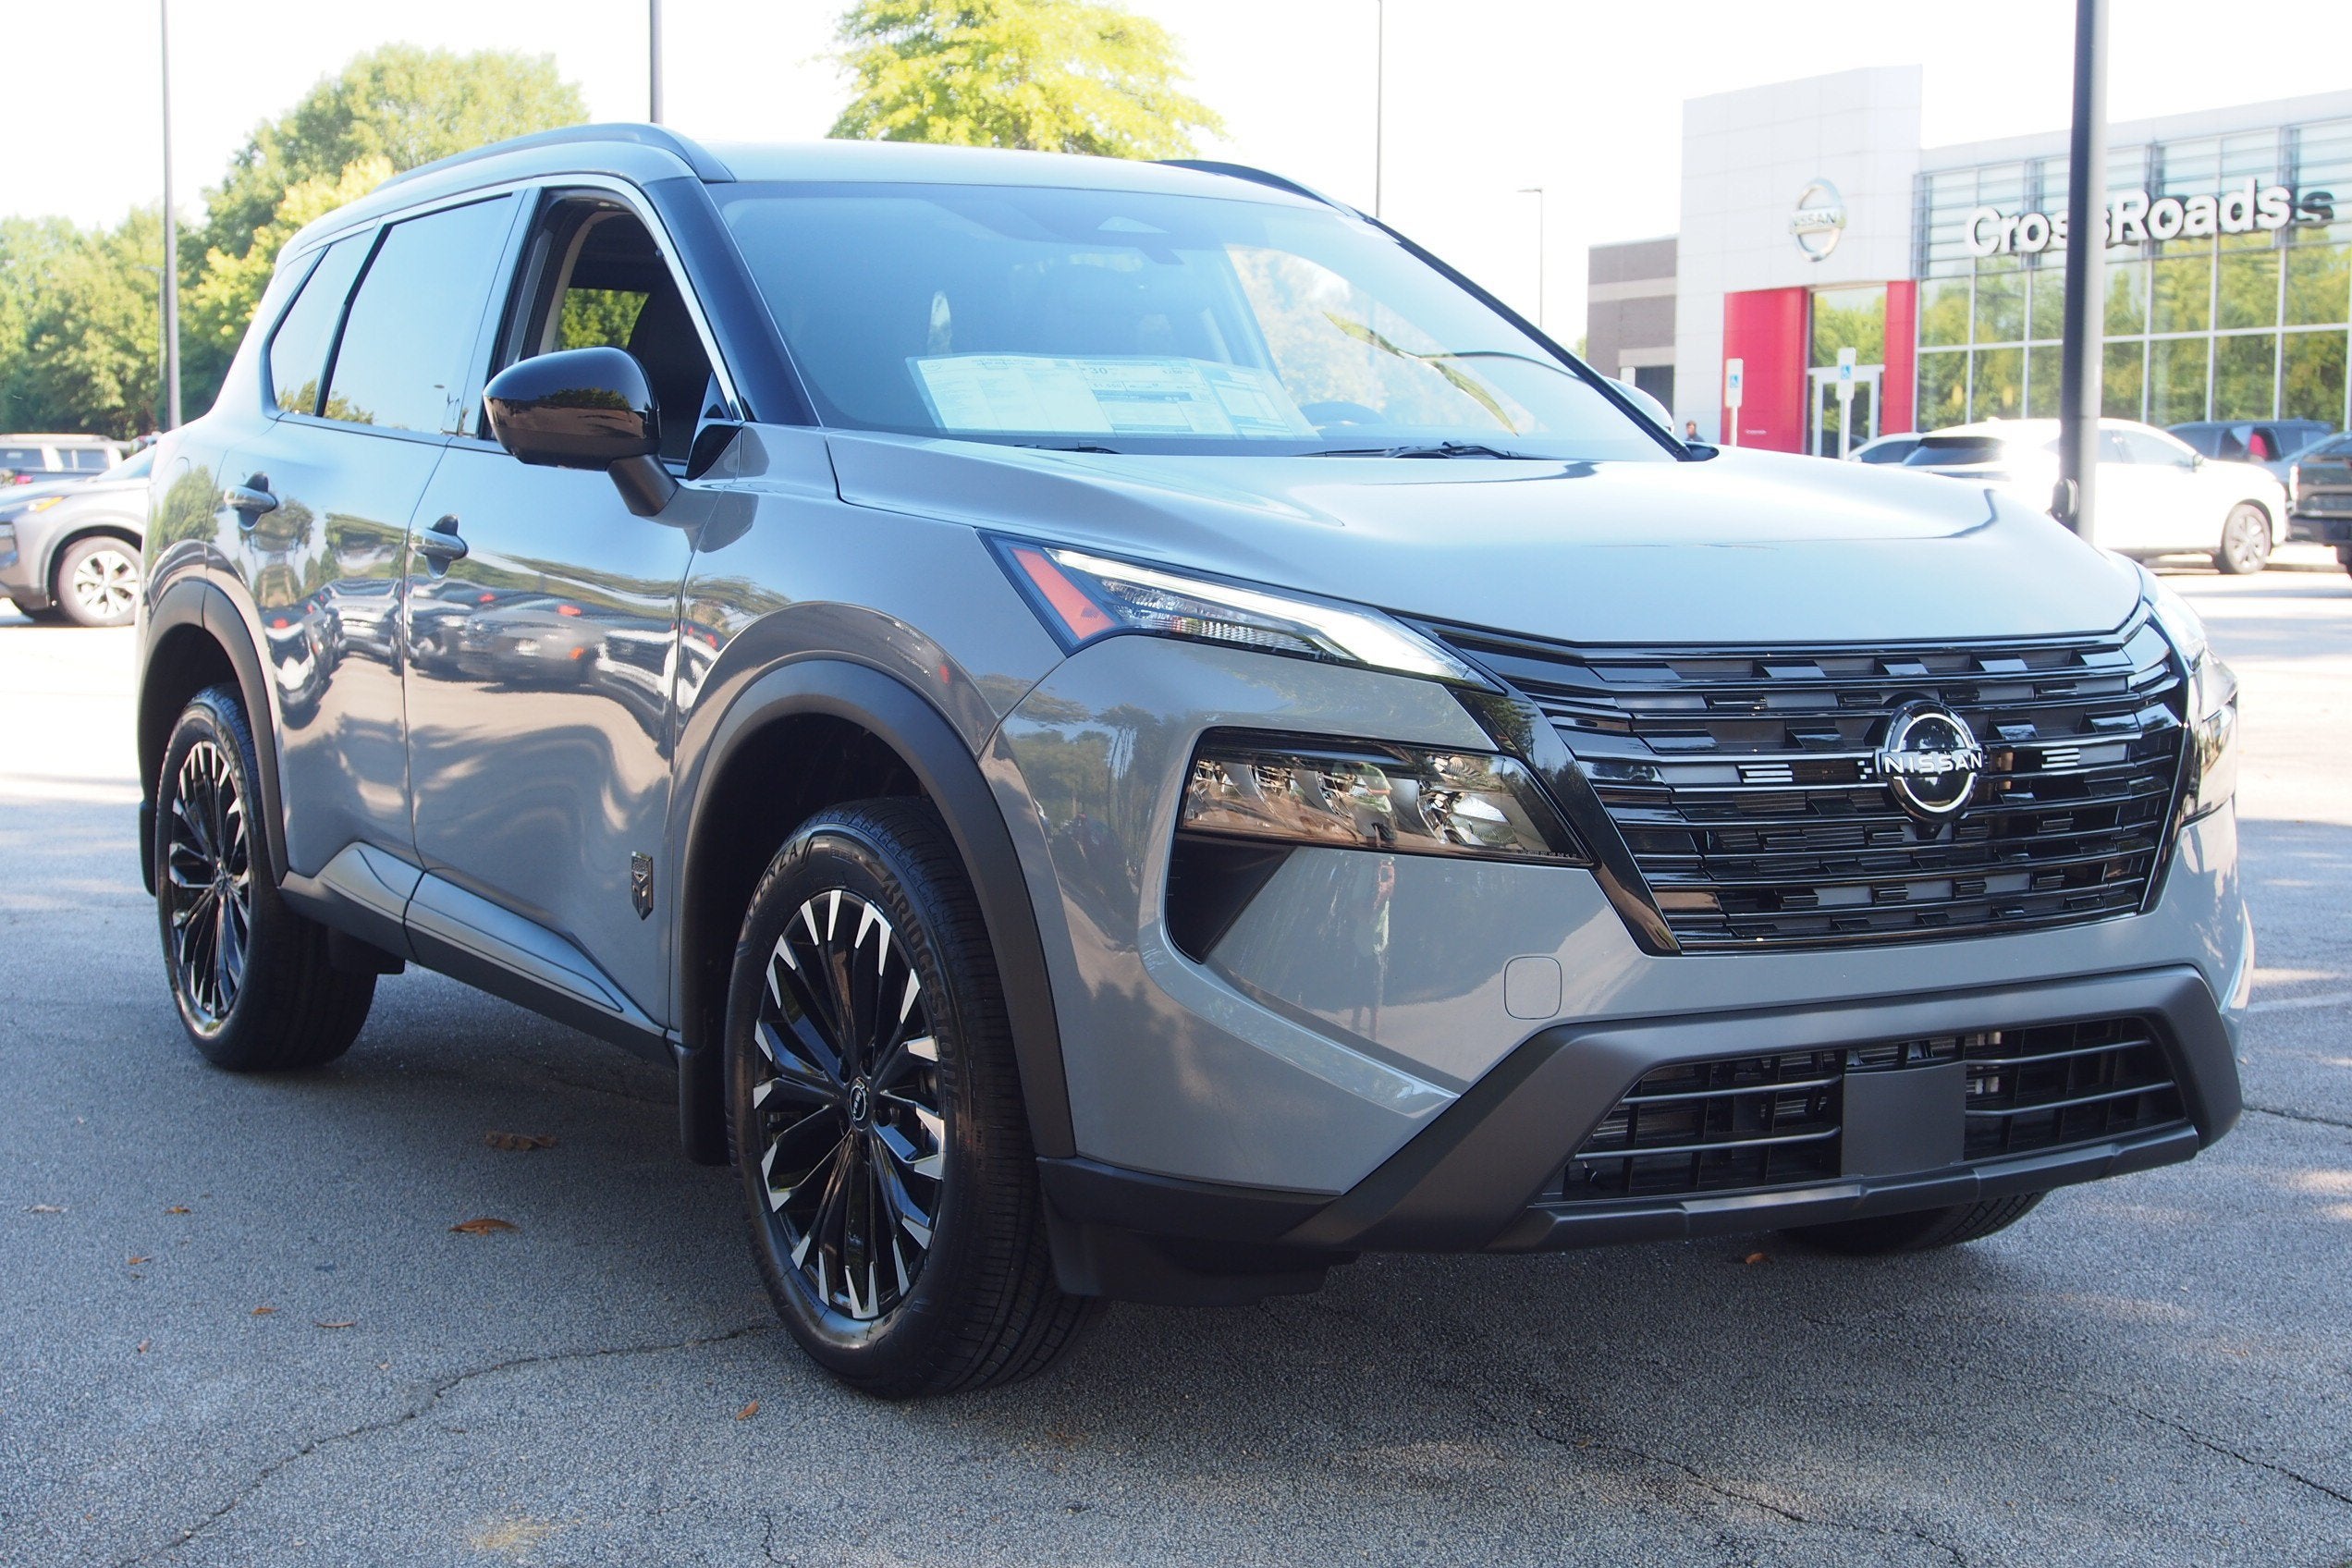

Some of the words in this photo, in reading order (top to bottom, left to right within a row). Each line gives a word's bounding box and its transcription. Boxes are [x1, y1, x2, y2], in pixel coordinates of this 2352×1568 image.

[1966, 177, 2292, 257] CrosRoads
[1883, 752, 1983, 775] NISSAN
[880, 871, 961, 1110] BRIDGESTONE
